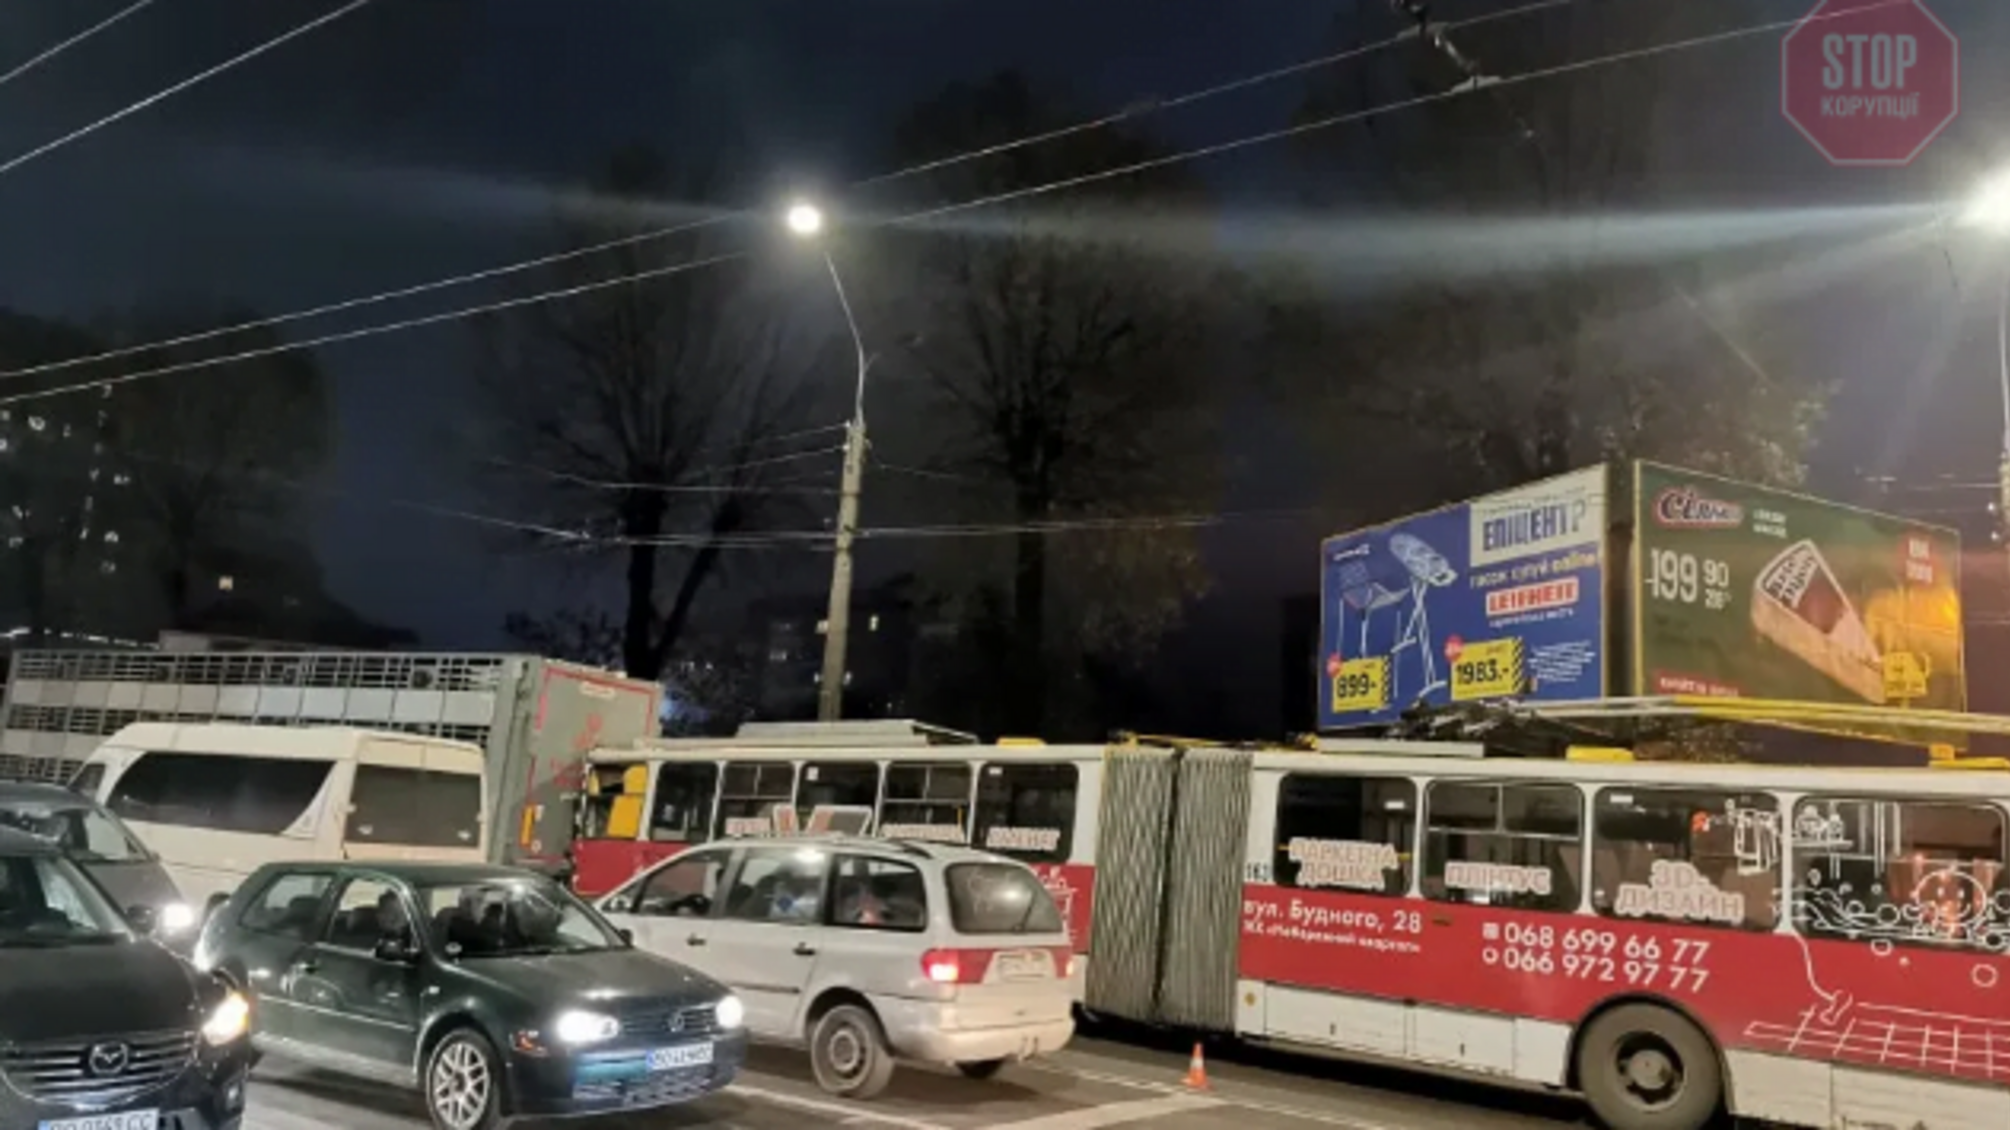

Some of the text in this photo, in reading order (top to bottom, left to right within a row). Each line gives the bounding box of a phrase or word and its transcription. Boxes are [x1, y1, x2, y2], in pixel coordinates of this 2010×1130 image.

[1618, 886, 1741, 917] ДИЗАЙН
[1393, 910, 1421, 934] 28
[1504, 922, 1710, 964] 068 699 66 77
[1504, 948, 1709, 993] 066 972 97 77
